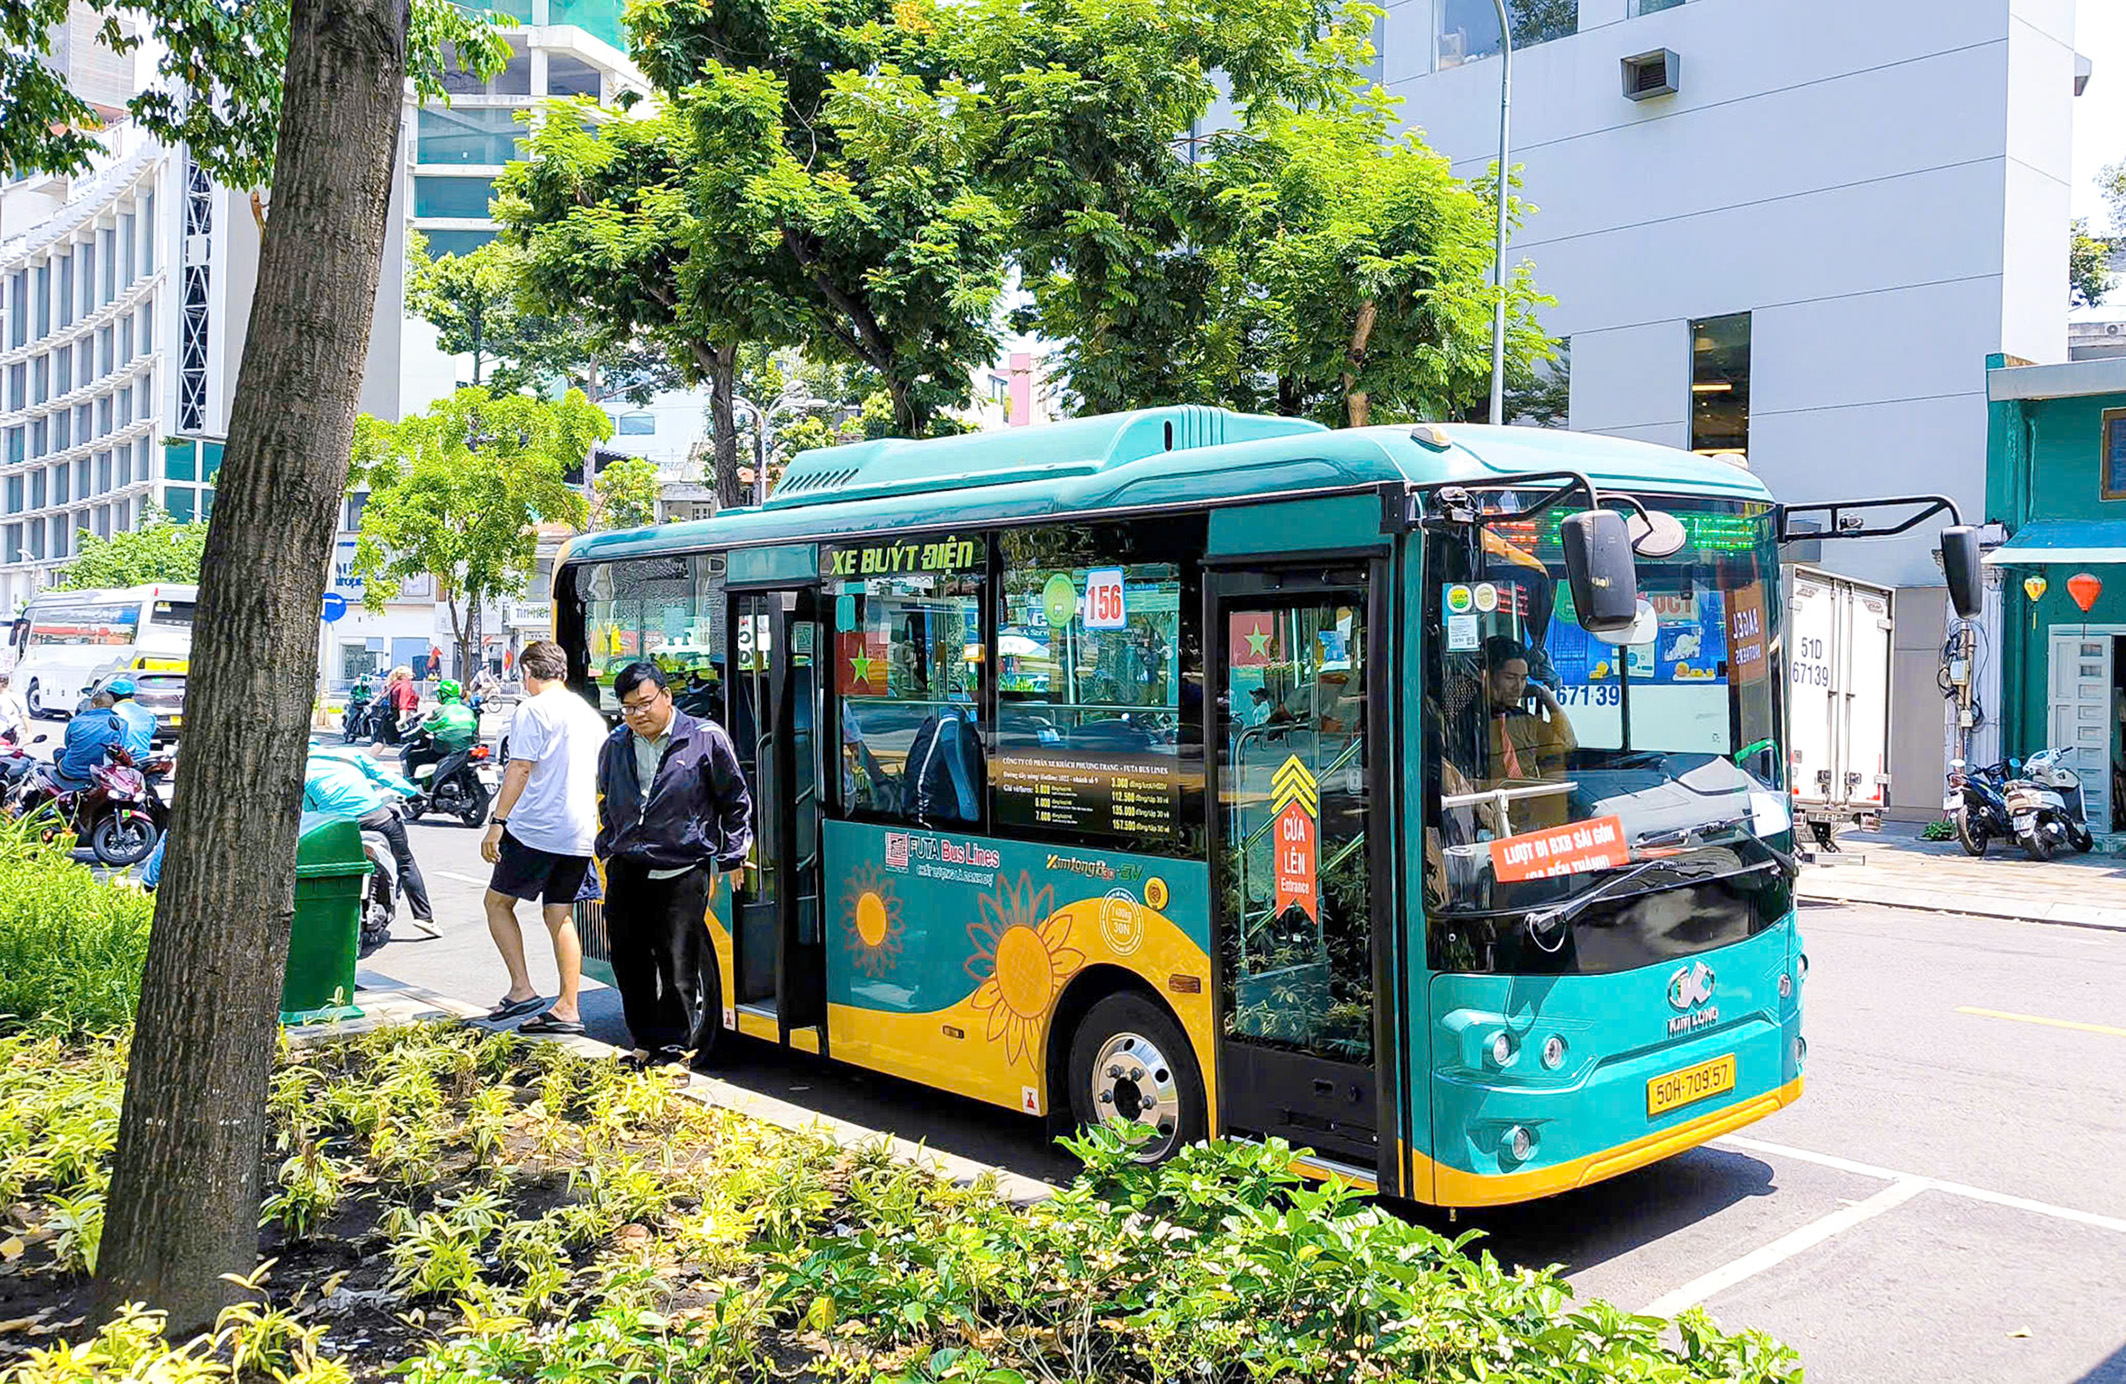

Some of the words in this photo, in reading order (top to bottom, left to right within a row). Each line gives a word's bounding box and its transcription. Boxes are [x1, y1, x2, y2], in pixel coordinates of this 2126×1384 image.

[830, 550, 858, 575] XE
[860, 539, 919, 574] BUÝT
[921, 535, 974, 575] ĐIỆN
[1088, 584, 1121, 620] 156
[1801, 637, 1823, 660] 51D
[1792, 661, 1829, 687] 67139
[1283, 811, 1306, 842] CỬA
[909, 834, 940, 860] FUTA
[940, 838, 965, 864] Bus
[965, 841, 1000, 868] Lines
[1503, 842, 1534, 866] LƯỢT
[1535, 838, 1549, 858] ĐI
[1549, 834, 1573, 855] BXB
[1573, 827, 1593, 849] SÀI
[1593, 823, 1616, 845] GÒN
[1284, 846, 1306, 875] LÊN
[1281, 877, 1310, 895] Entrance
[1692, 1006, 1720, 1029] LONG
[1657, 1064, 1728, 1105] 50H-709.57
